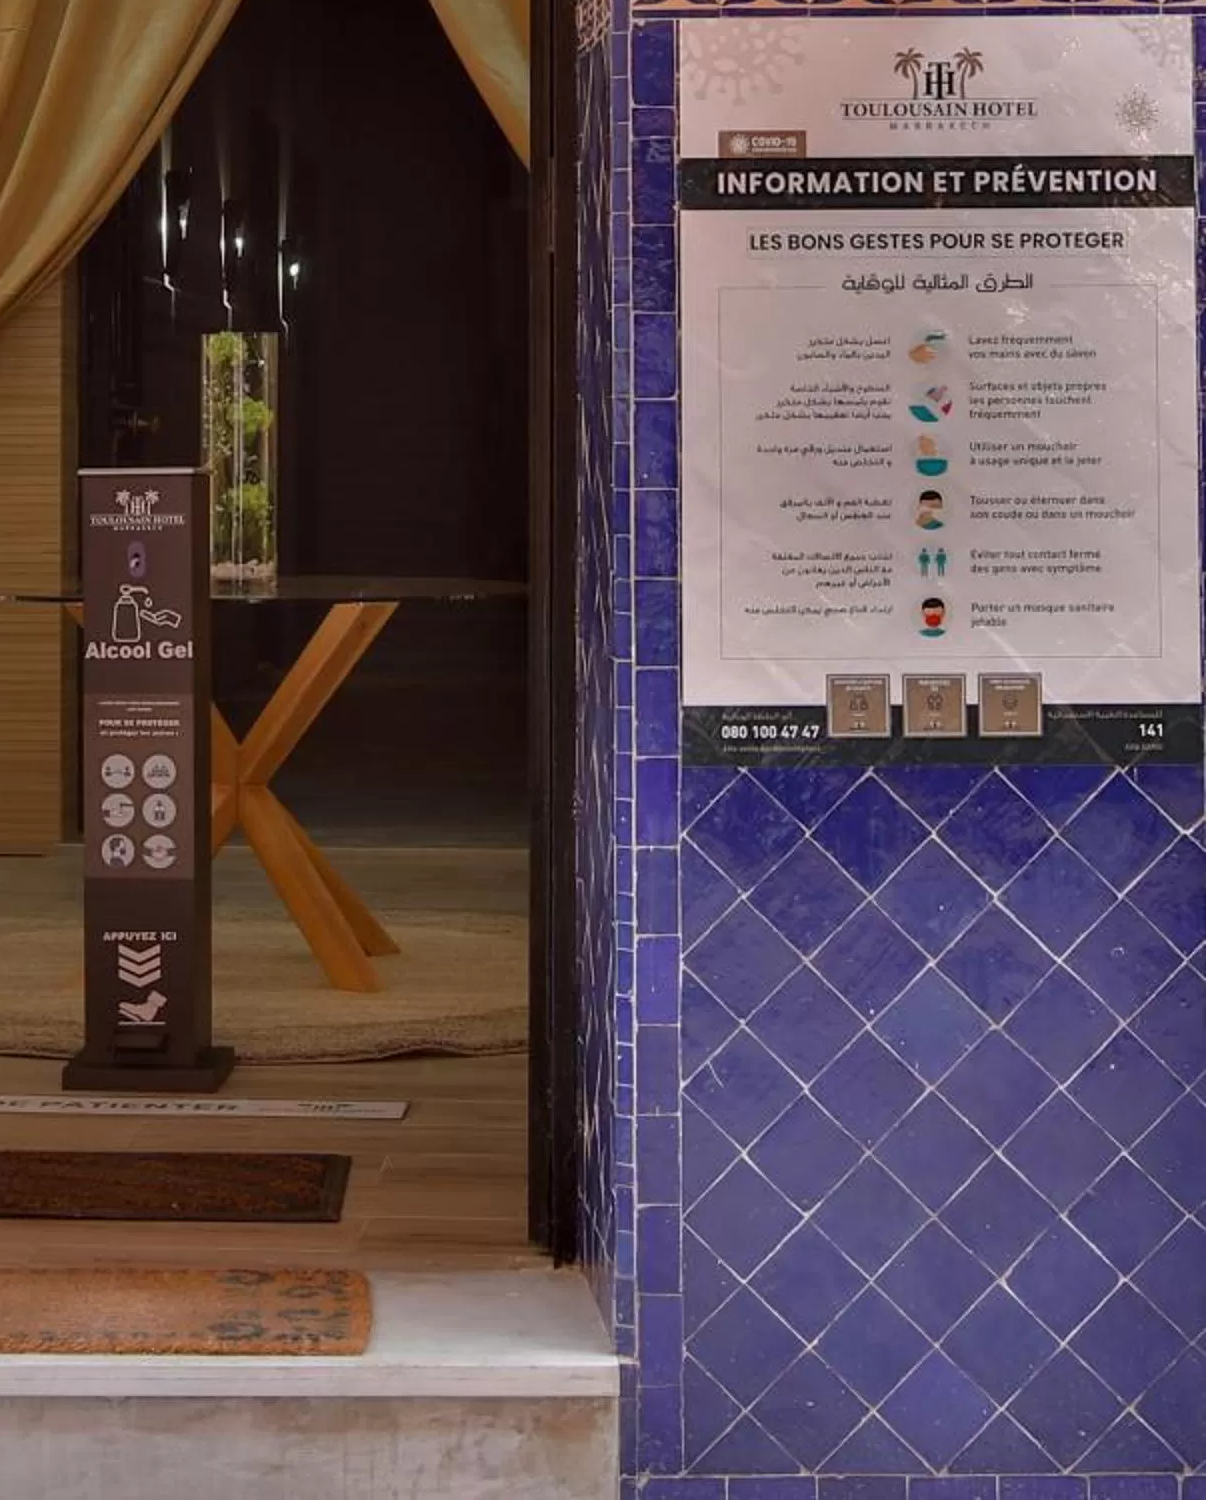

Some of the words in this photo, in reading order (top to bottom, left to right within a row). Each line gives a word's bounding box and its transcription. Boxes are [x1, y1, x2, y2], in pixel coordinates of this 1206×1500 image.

[840, 102, 968, 117] TOULOUSAIN
[973, 102, 1038, 116] HOTEL
[717, 171, 924, 195] INFORMATION
[933, 170, 963, 193] ET
[974, 164, 1158, 194] PRÉVENTION
[749, 234, 783, 250] LES
[788, 234, 844, 250] BONS
[850, 233, 924, 250] GESTES
[929, 233, 984, 249] POUR
[991, 233, 1014, 249] SE
[1020, 232, 1124, 249] PROTEGER
[841, 273, 905, 294] للوقاية
[912, 273, 969, 294] المثالية
[975, 272, 1033, 293] الطرق
[968, 334, 998, 346] Lavez
[989, 349, 1020, 359] mains
[1024, 349, 1048, 359] avec
[1050, 349, 1063, 359] du
[153, 515, 185, 525] HOTEL
[85, 642, 151, 659] Alcool
[158, 641, 193, 659] Gel
[720, 725, 748, 739] 080
[752, 725, 777, 739] 100
[781, 725, 798, 739] 47
[801, 725, 820, 739] 47
[1138, 723, 1163, 737] 141
[103, 932, 157, 941] APPUYEZ
[161, 932, 177, 940] ICI
[40, 1100, 237, 1111] PATIENTER
